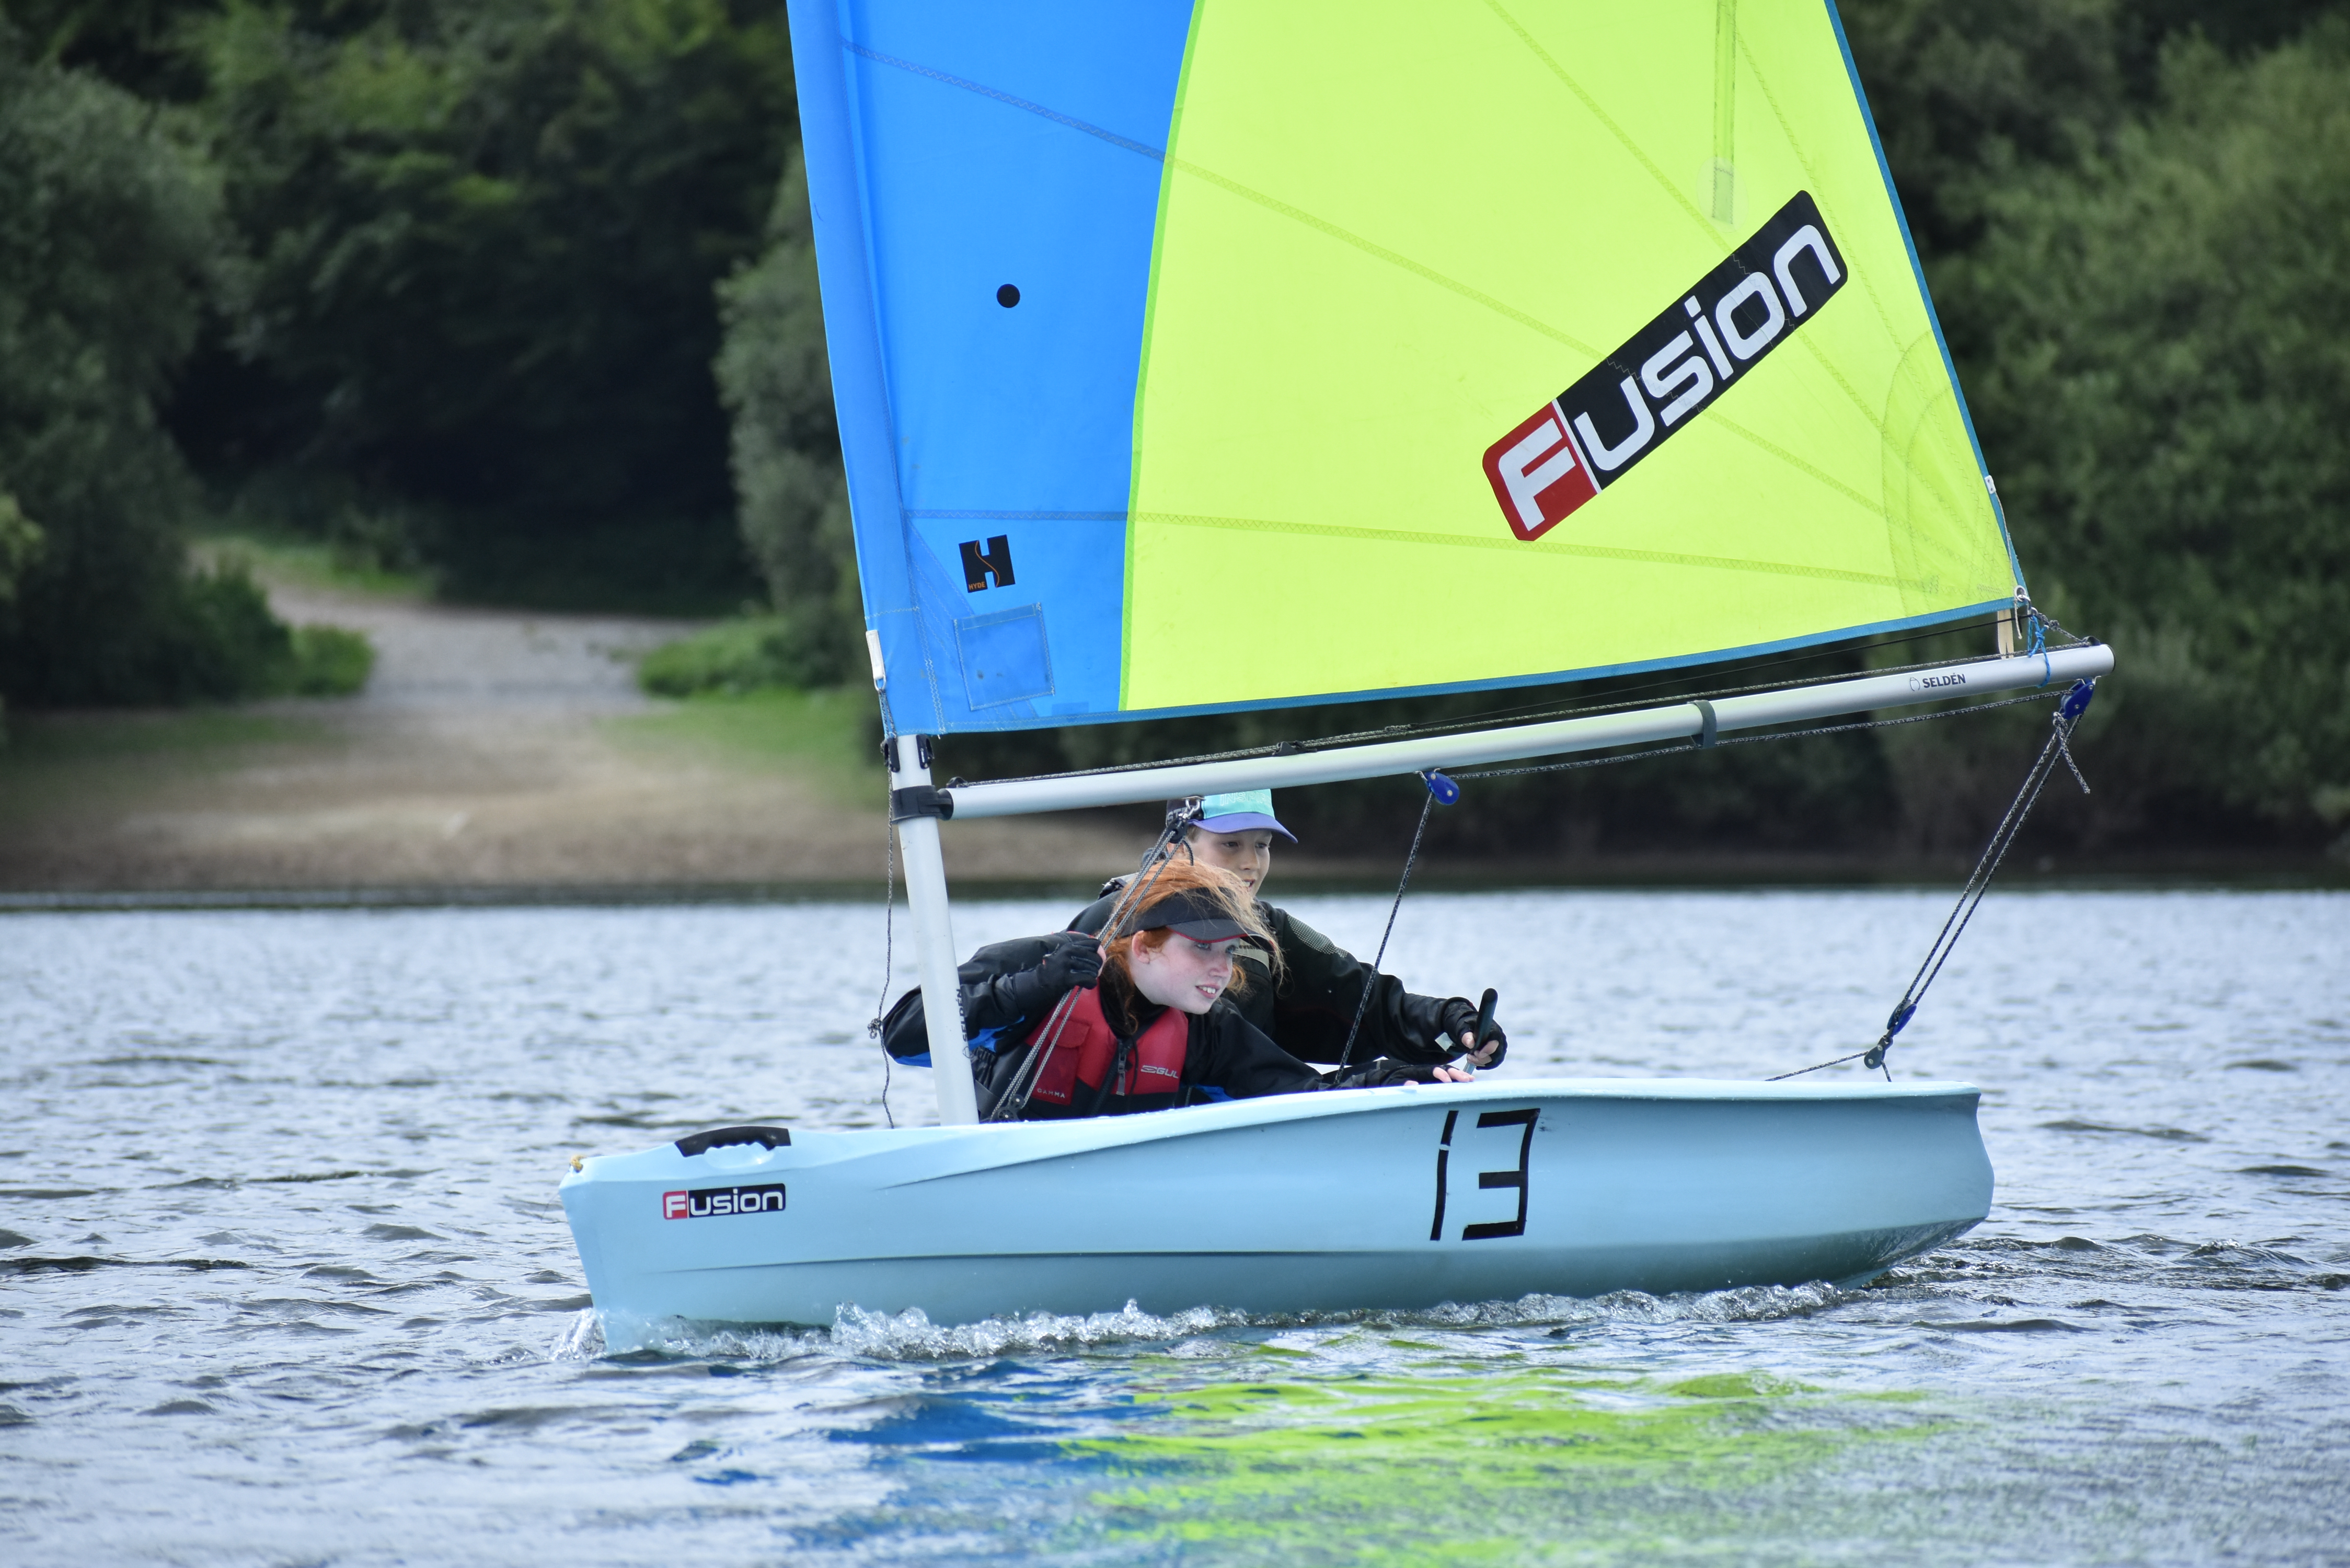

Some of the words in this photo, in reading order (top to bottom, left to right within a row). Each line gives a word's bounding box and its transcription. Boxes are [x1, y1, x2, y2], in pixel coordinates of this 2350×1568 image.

[1498, 224, 1841, 532] Fusion
[969, 581, 986, 590] HYDE
[1922, 672, 1966, 688] SELDÉN
[1156, 1067, 1179, 1079] GUL
[1037, 1088, 1065, 1098] GAMMA
[1430, 1108, 1541, 1241] 13
[665, 1188, 784, 1218] Fusion
